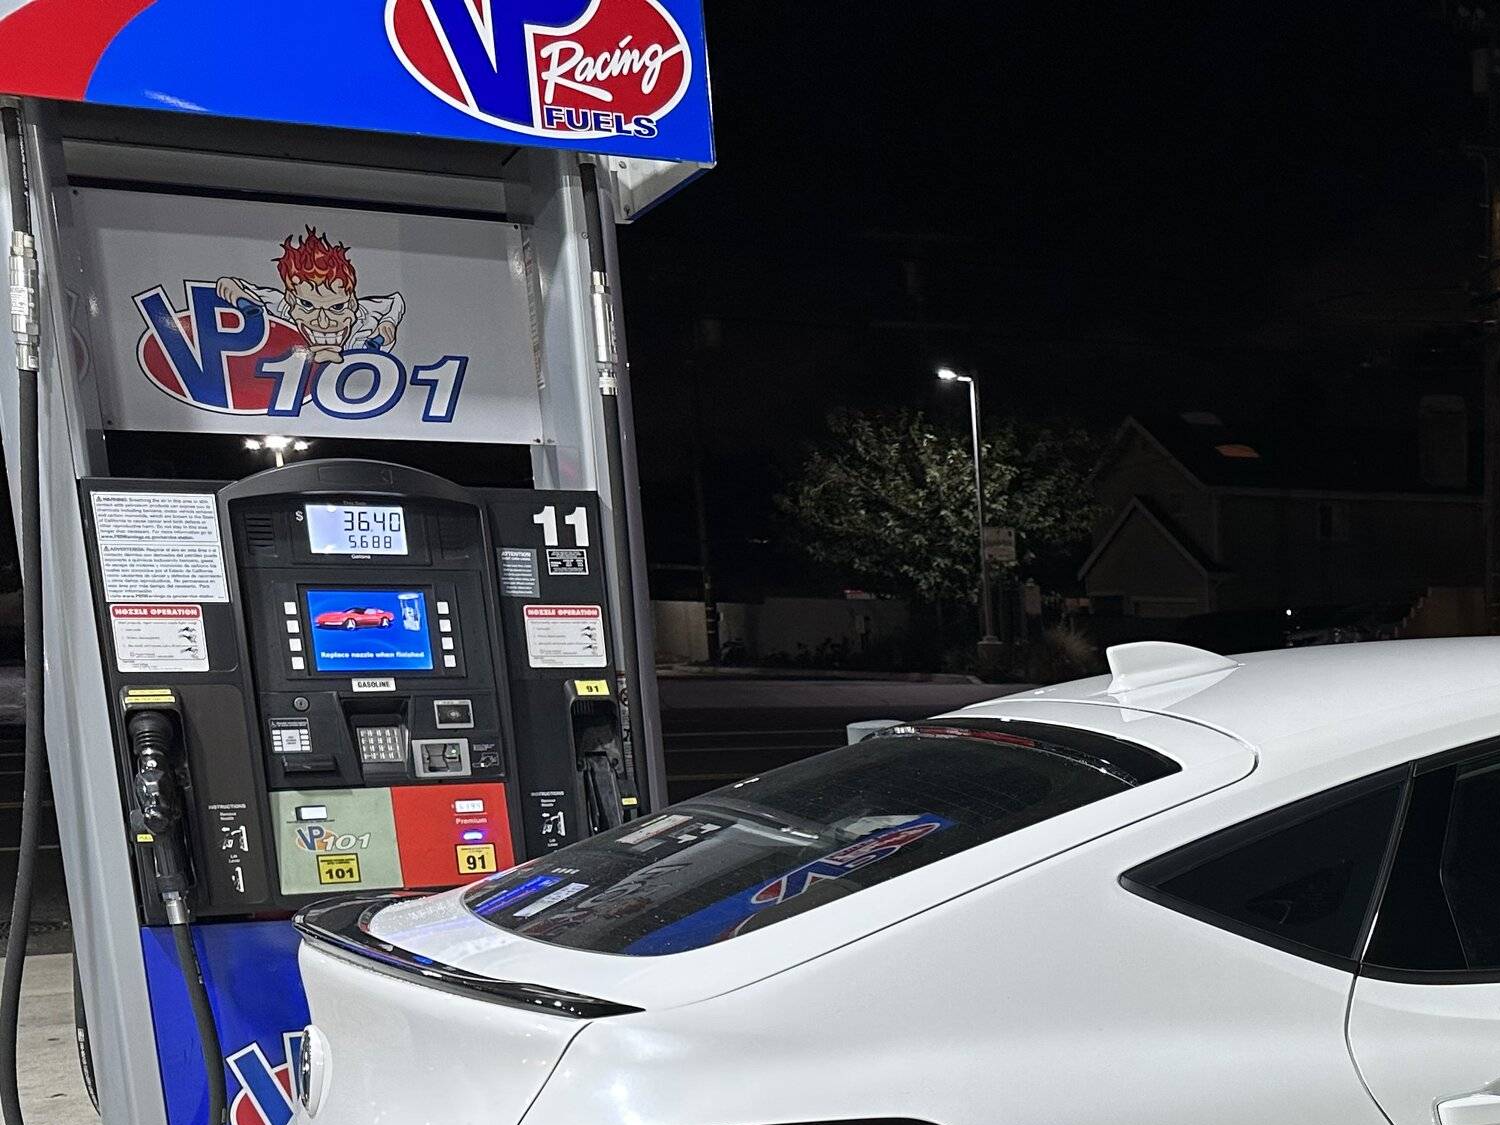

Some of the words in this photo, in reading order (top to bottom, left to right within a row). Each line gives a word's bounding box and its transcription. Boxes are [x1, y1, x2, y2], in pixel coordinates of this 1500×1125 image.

[540, 35, 680, 104] Racing
[544, 106, 658, 138] FUELS
[135, 281, 268, 412] VP
[254, 350, 469, 423] 101
[344, 511, 401, 532] 36.40
[533, 505, 589, 547] 11
[348, 535, 392, 549] 5.688
[114, 608, 149, 616] NOZZLE
[150, 608, 198, 616] OPERATION
[320, 651, 350, 659] Replace
[586, 685, 599, 693] 91
[455, 817, 488, 825] Premium
[323, 832, 372, 851] 101
[466, 854, 486, 871] 91
[325, 867, 354, 880] 101
